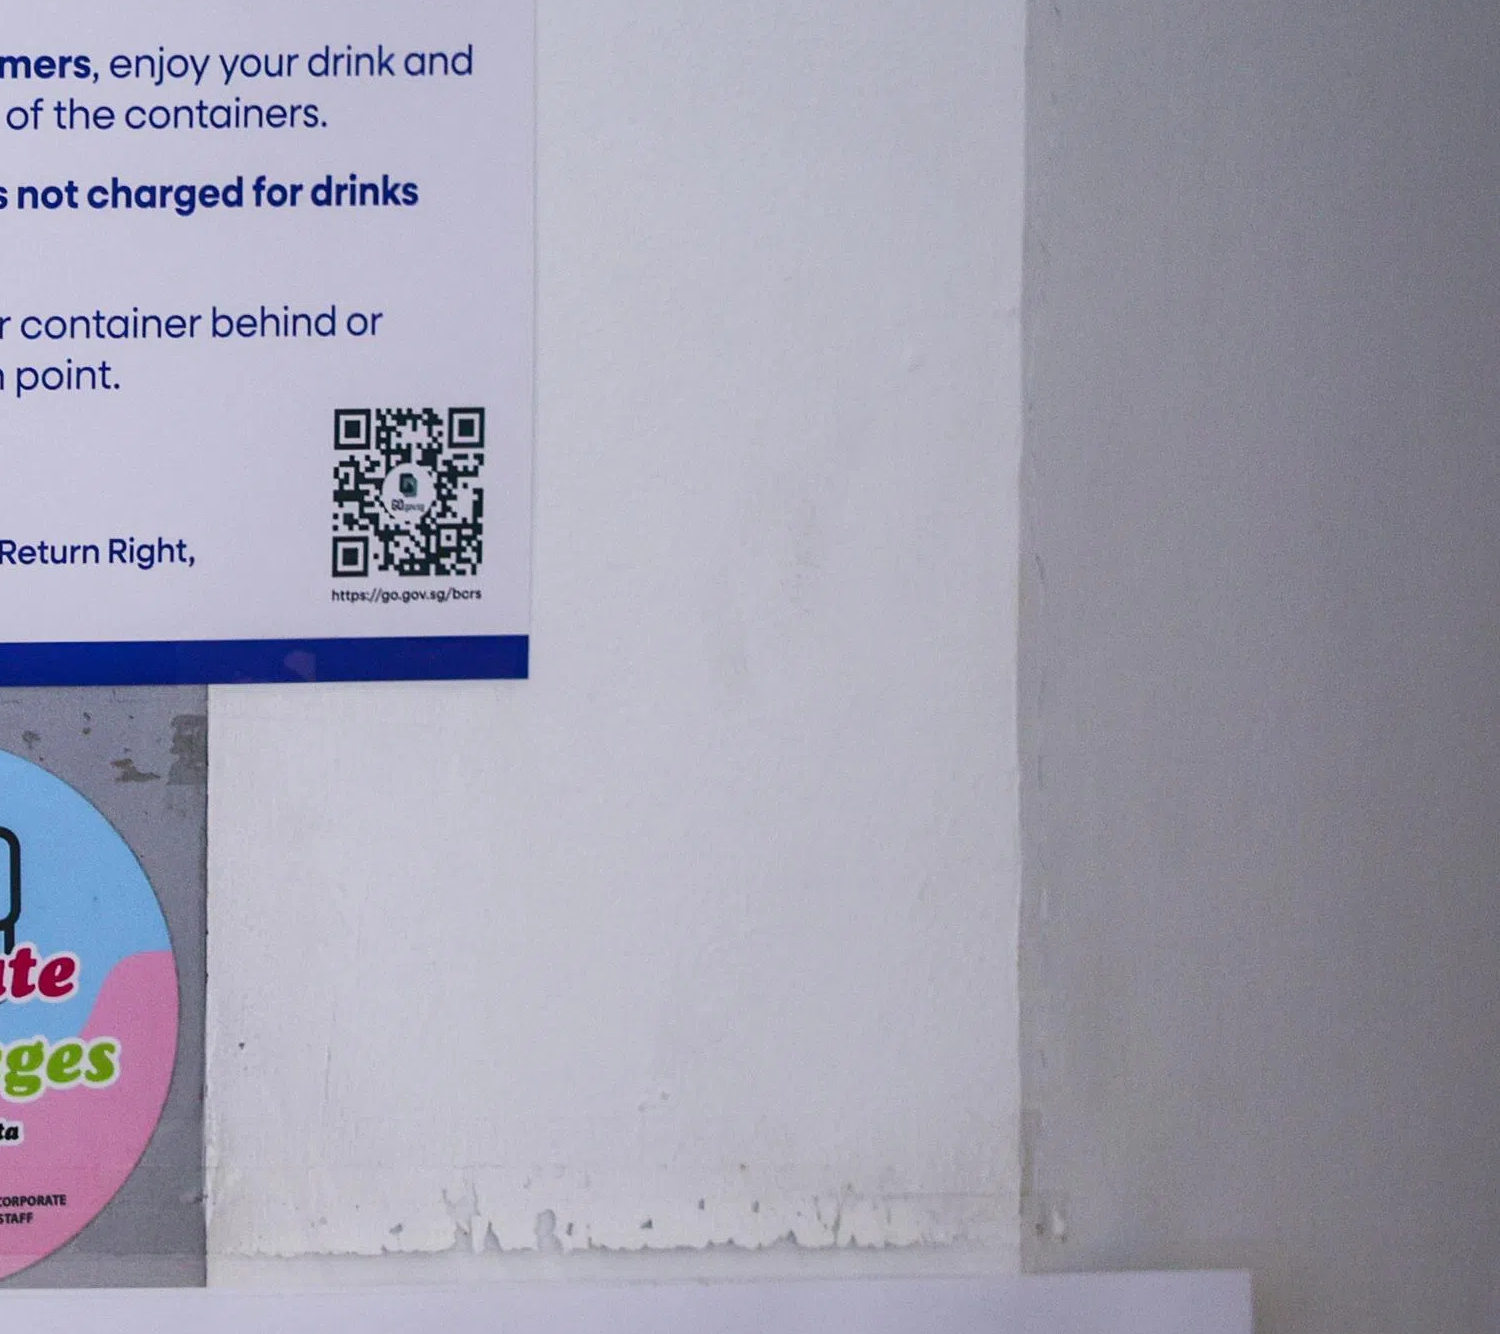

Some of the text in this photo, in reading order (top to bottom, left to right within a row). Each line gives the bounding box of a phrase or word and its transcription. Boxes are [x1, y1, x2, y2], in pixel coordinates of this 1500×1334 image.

[110, 47, 210, 86] enjoy
[220, 54, 299, 85] your
[308, 45, 394, 77] drink
[404, 44, 472, 76] and
[18, 181, 78, 209] not
[87, 176, 243, 216] charged
[252, 175, 303, 207] for
[311, 173, 418, 206] drinks
[109, 537, 195, 570] Right,
[331, 587, 482, 604] https://go.gov.sg/bcrs
